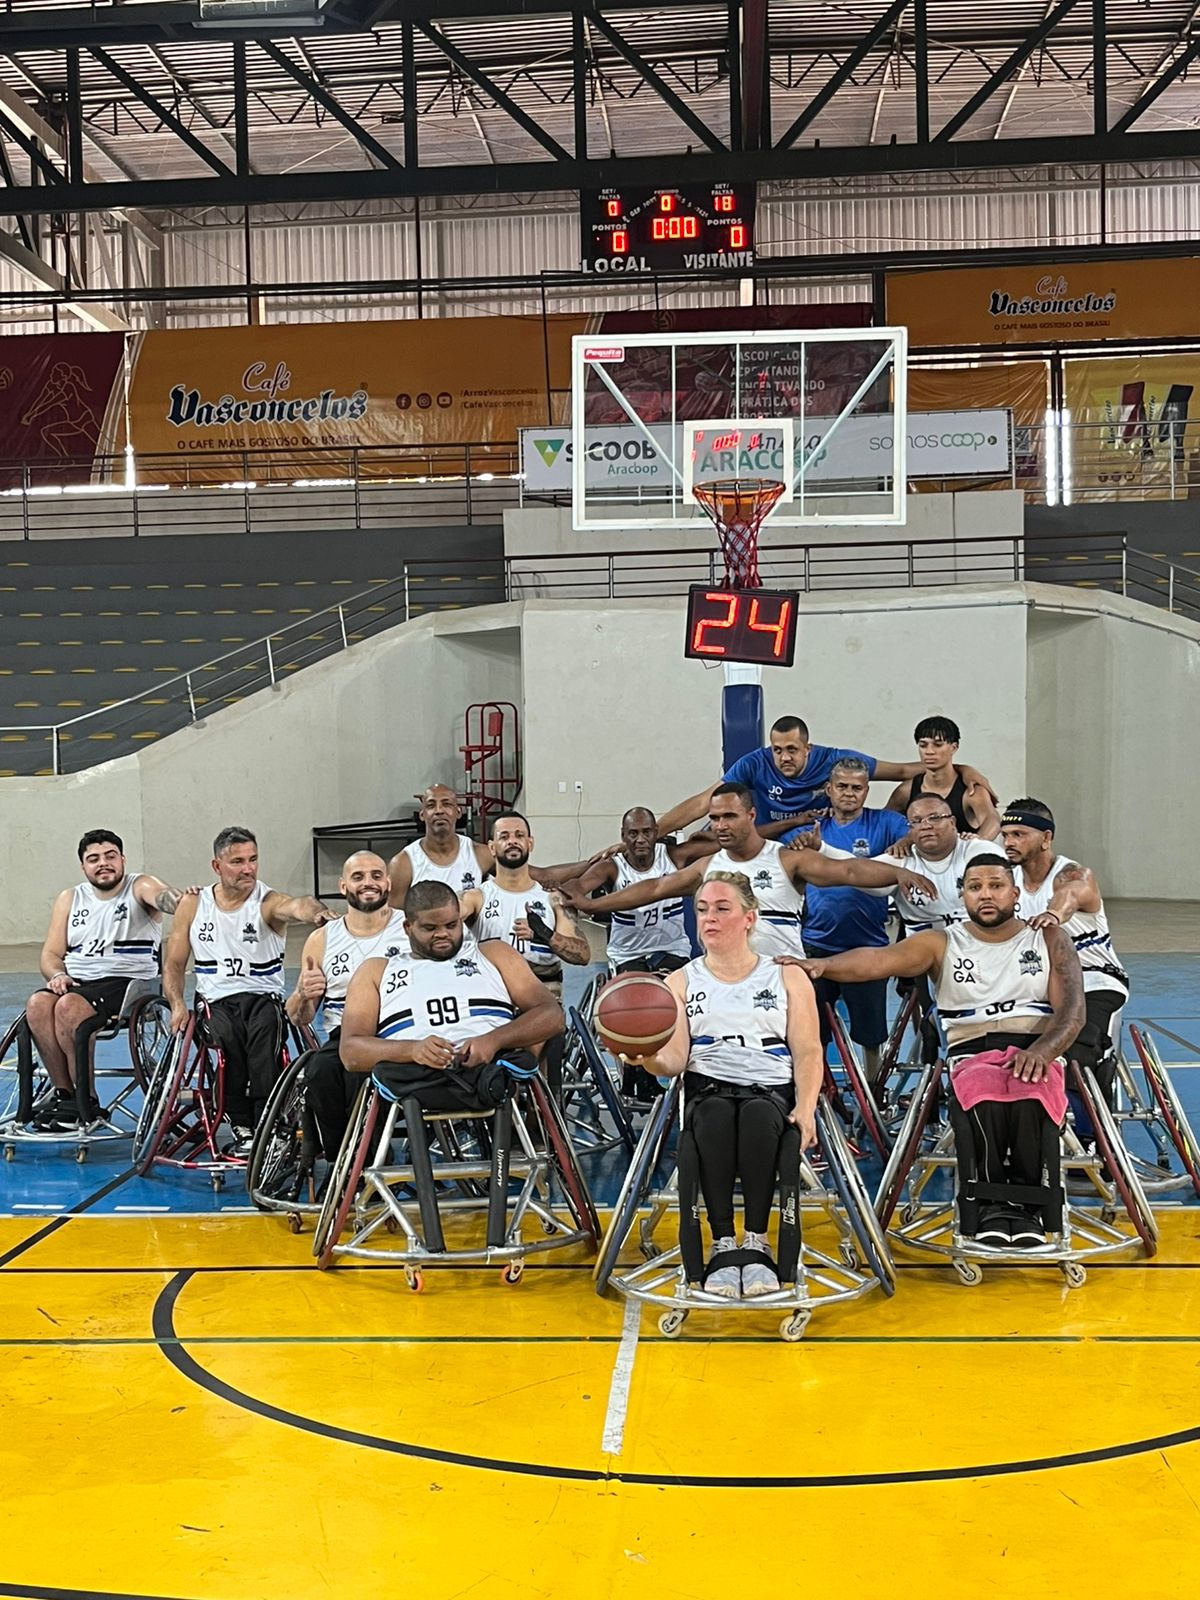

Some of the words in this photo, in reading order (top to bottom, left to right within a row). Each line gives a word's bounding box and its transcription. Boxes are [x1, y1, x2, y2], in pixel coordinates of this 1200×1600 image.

[608, 201, 618, 216] 0
[661, 195, 671, 211] 0
[714, 196, 732, 211] 18
[653, 217, 696, 239] 0:00
[707, 218, 743, 226] PONTOS
[613, 231, 625, 252] 0
[731, 226, 743, 247] 0
[582, 256, 651, 274] LOCAL
[683, 251, 753, 270] VISITANTE
[989, 288, 1116, 316] Vasconcelos
[242, 361, 291, 398] Café
[167, 384, 369, 427] Vasconcelos
[177, 440, 186, 449] O
[218, 438, 246, 448] MAIS
[250, 436, 299, 447] GOSTOSO
[302, 436, 318, 446] DO
[694, 592, 789, 656] 24
[768, 785, 783, 795] JO
[486, 900, 500, 910] JO
[73, 909, 89, 917] JO
[485, 911, 499, 919] GA
[643, 907, 658, 928] 23
[72, 919, 86, 927] GA
[200, 922, 214, 932] JO
[198, 933, 214, 942] GA
[85, 938, 105, 957] 24
[332, 953, 349, 966] JO
[953, 958, 974, 970] JO
[224, 958, 245, 977] 32
[332, 965, 350, 977] GA
[953, 971, 976, 984] GA
[686, 991, 706, 1004] JO
[426, 996, 460, 1026] 99
[685, 1004, 704, 1018] GA
